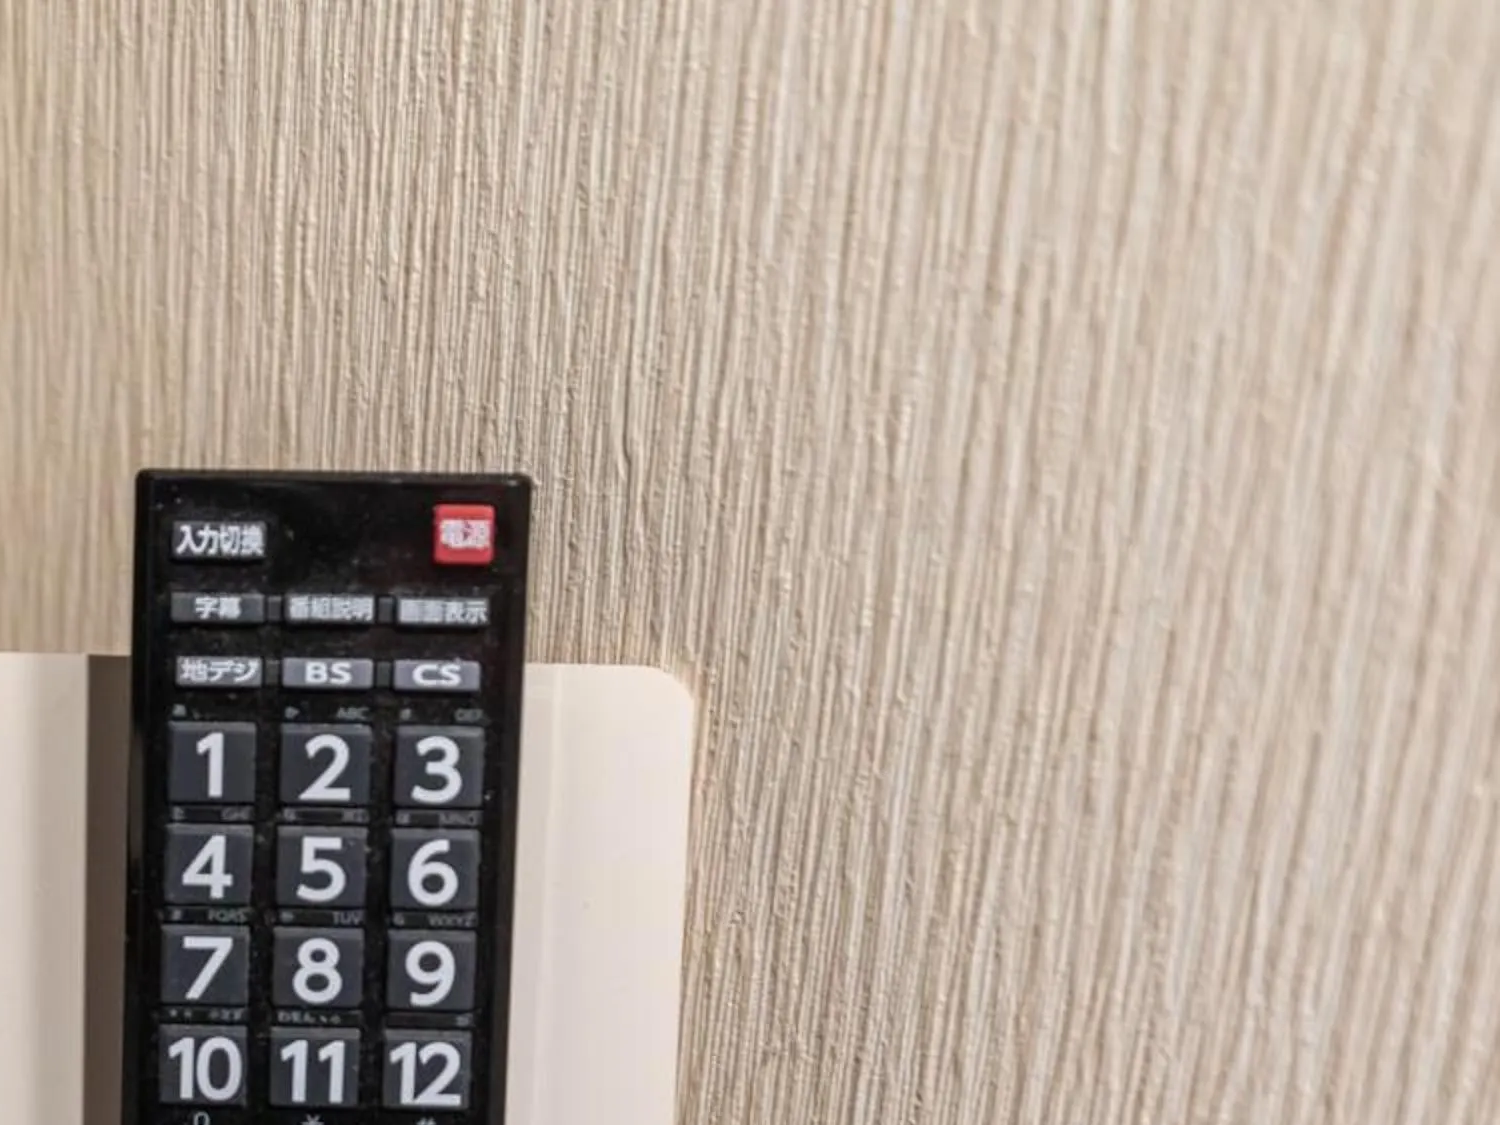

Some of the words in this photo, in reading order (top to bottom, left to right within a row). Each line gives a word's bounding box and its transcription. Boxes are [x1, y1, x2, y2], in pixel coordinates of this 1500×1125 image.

[180, 660, 260, 684] 地デジ
[304, 662, 352, 685] BS
[412, 663, 462, 687] CS
[196, 732, 225, 799] 1
[299, 733, 352, 801] 2
[411, 735, 463, 804] 3
[181, 834, 234, 900] 4
[296, 836, 347, 902] 5
[407, 838, 459, 907] 6
[182, 936, 234, 1000] 7
[292, 936, 343, 1004] 8
[404, 939, 456, 1007] 9
[167, 1035, 243, 1101] 10
[279, 1038, 347, 1104] 11
[388, 1040, 462, 1107] 12
